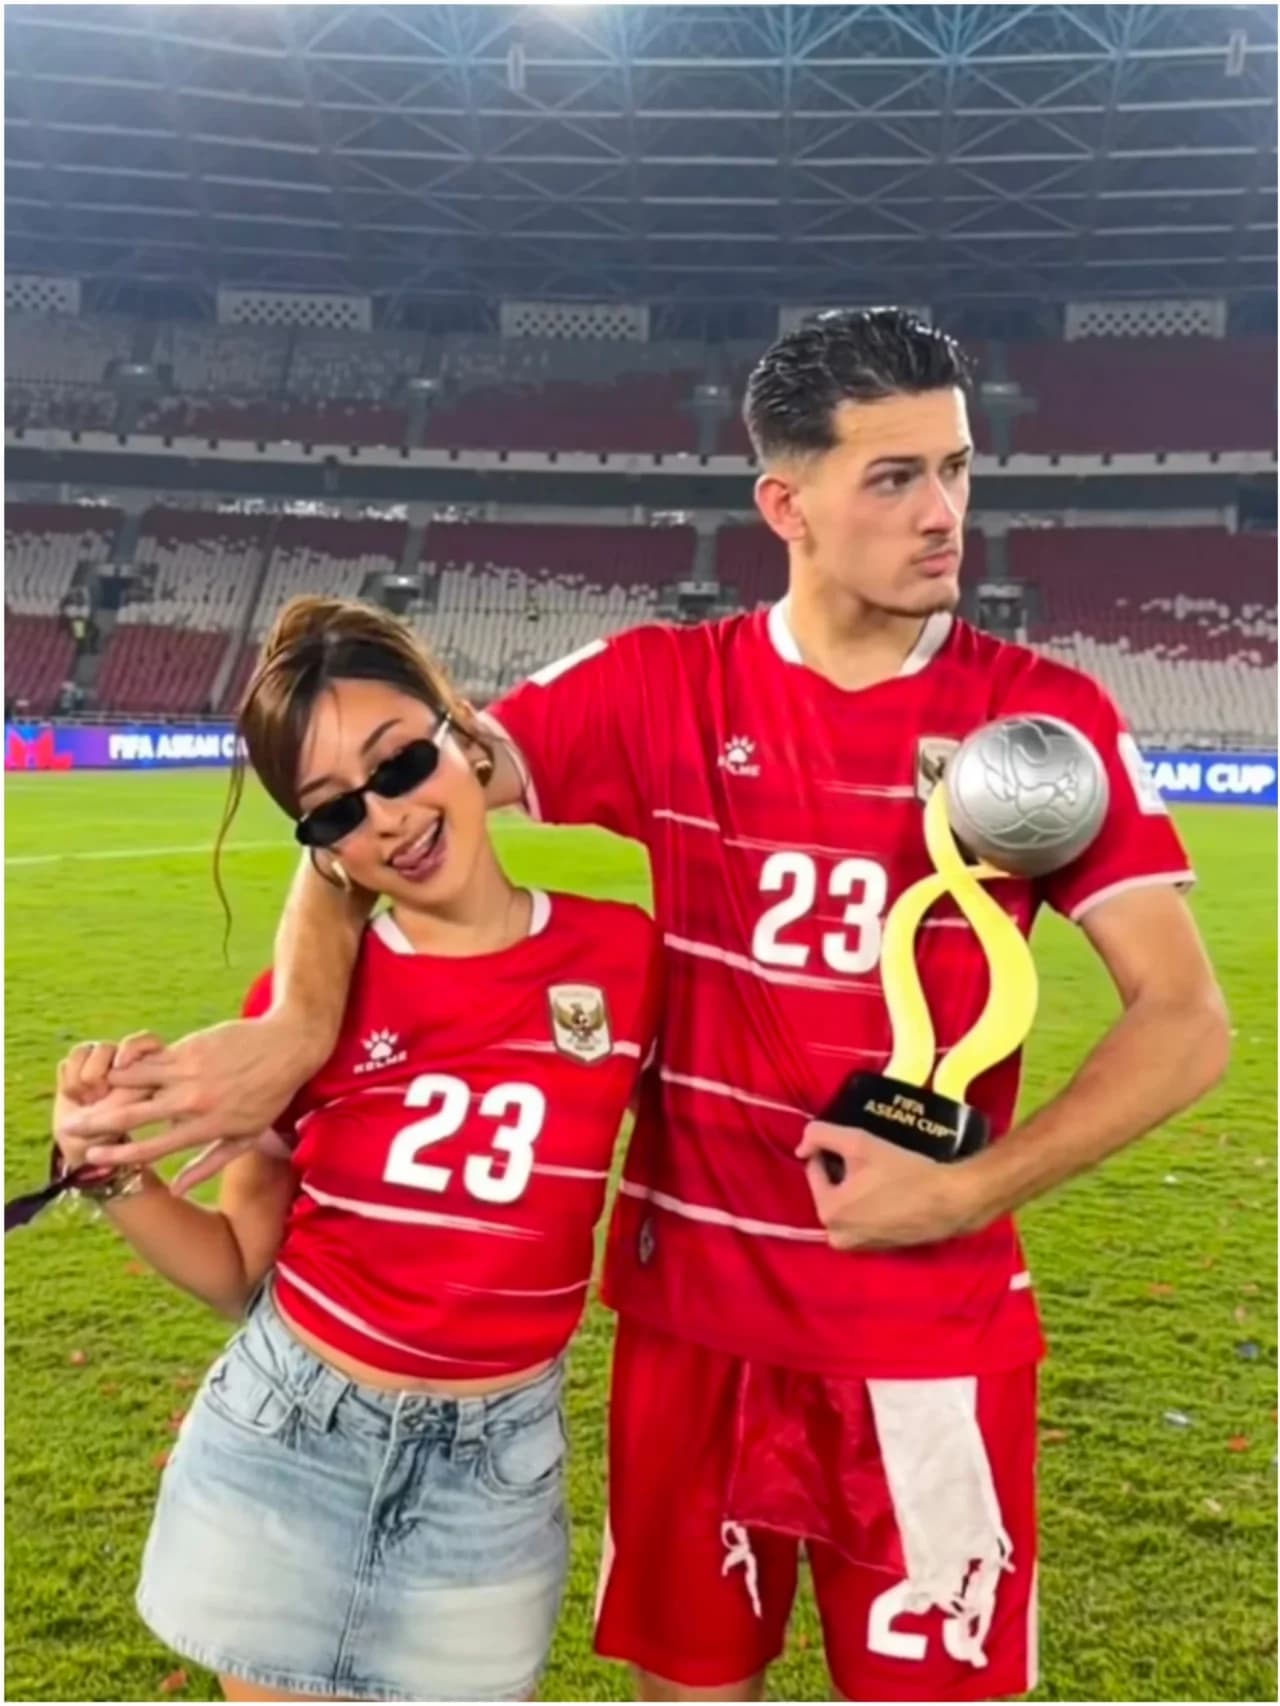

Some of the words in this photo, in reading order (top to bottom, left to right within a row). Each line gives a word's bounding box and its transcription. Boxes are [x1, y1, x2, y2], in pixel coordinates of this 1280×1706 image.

[1205, 763, 1275, 794] CUP
[752, 851, 889, 974] 23
[382, 1072, 546, 1204] 23
